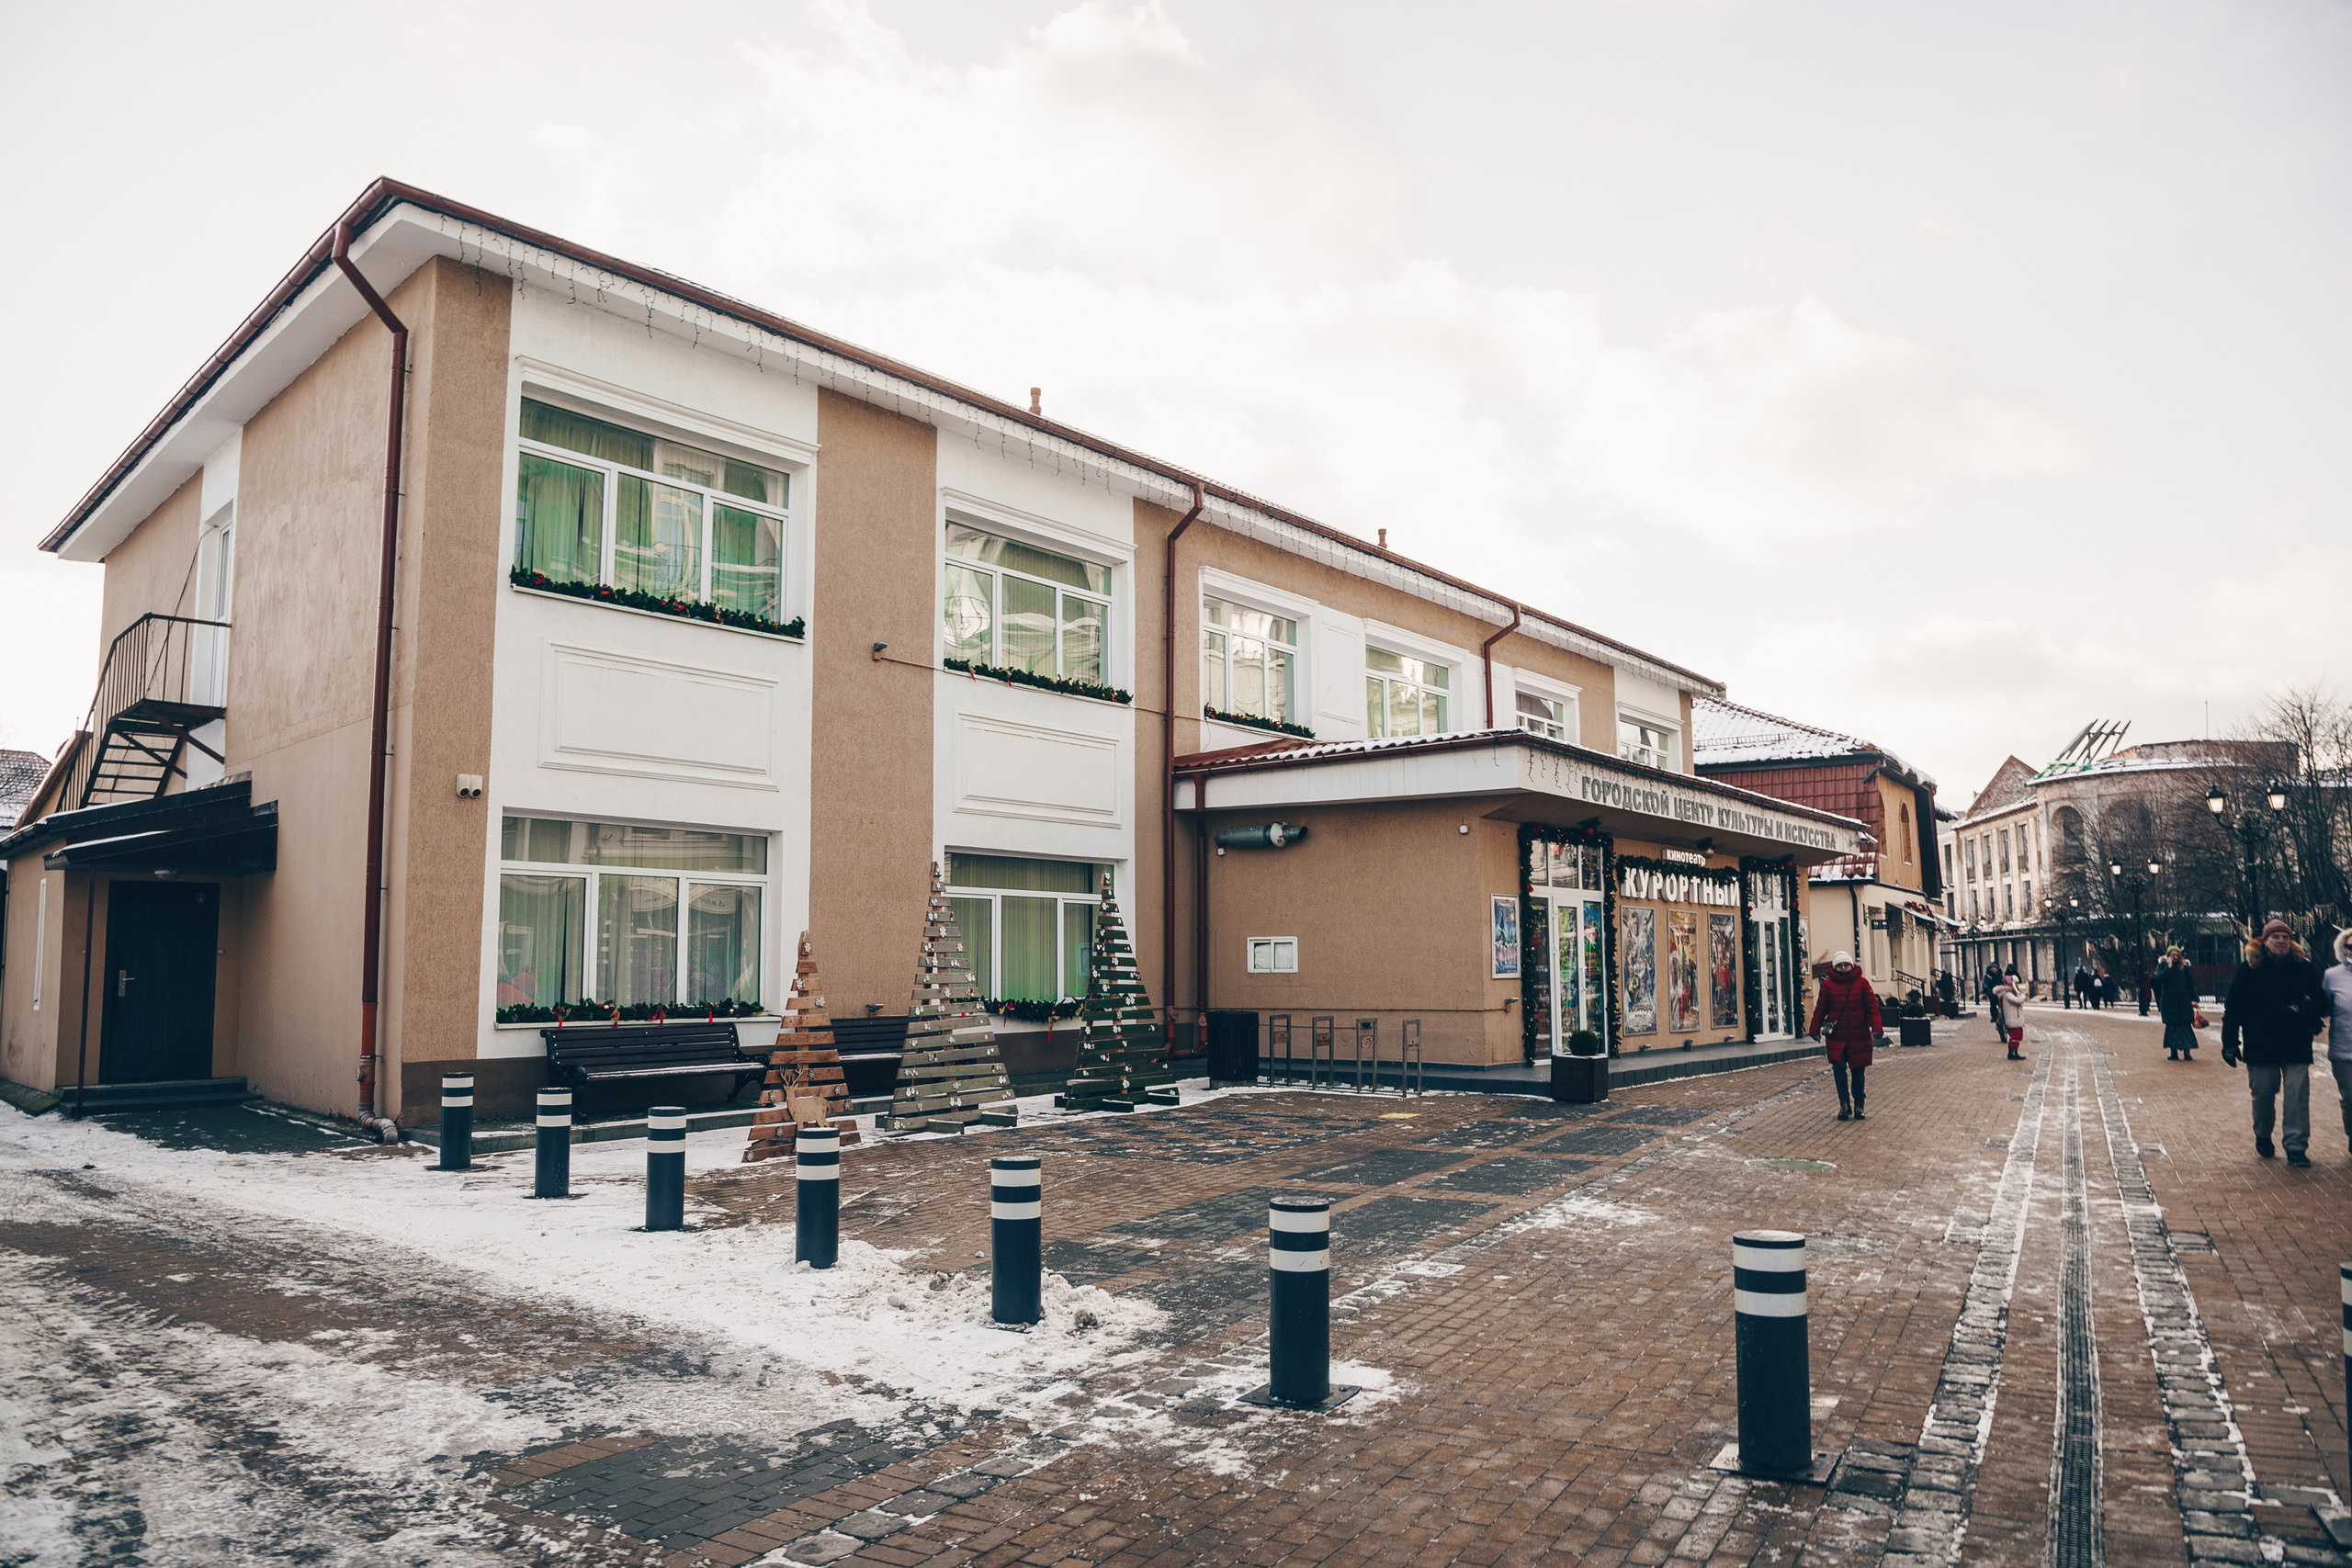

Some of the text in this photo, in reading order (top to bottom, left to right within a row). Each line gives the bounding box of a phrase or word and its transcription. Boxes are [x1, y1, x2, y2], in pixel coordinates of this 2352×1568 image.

[1581, 775, 1837, 850] ГОРОДСКОЙ ЦЕНТР КУЛЬТУРЫ И ИСКУССТВА
[1622, 866, 1740, 907] КУРОРТНЫЙ
